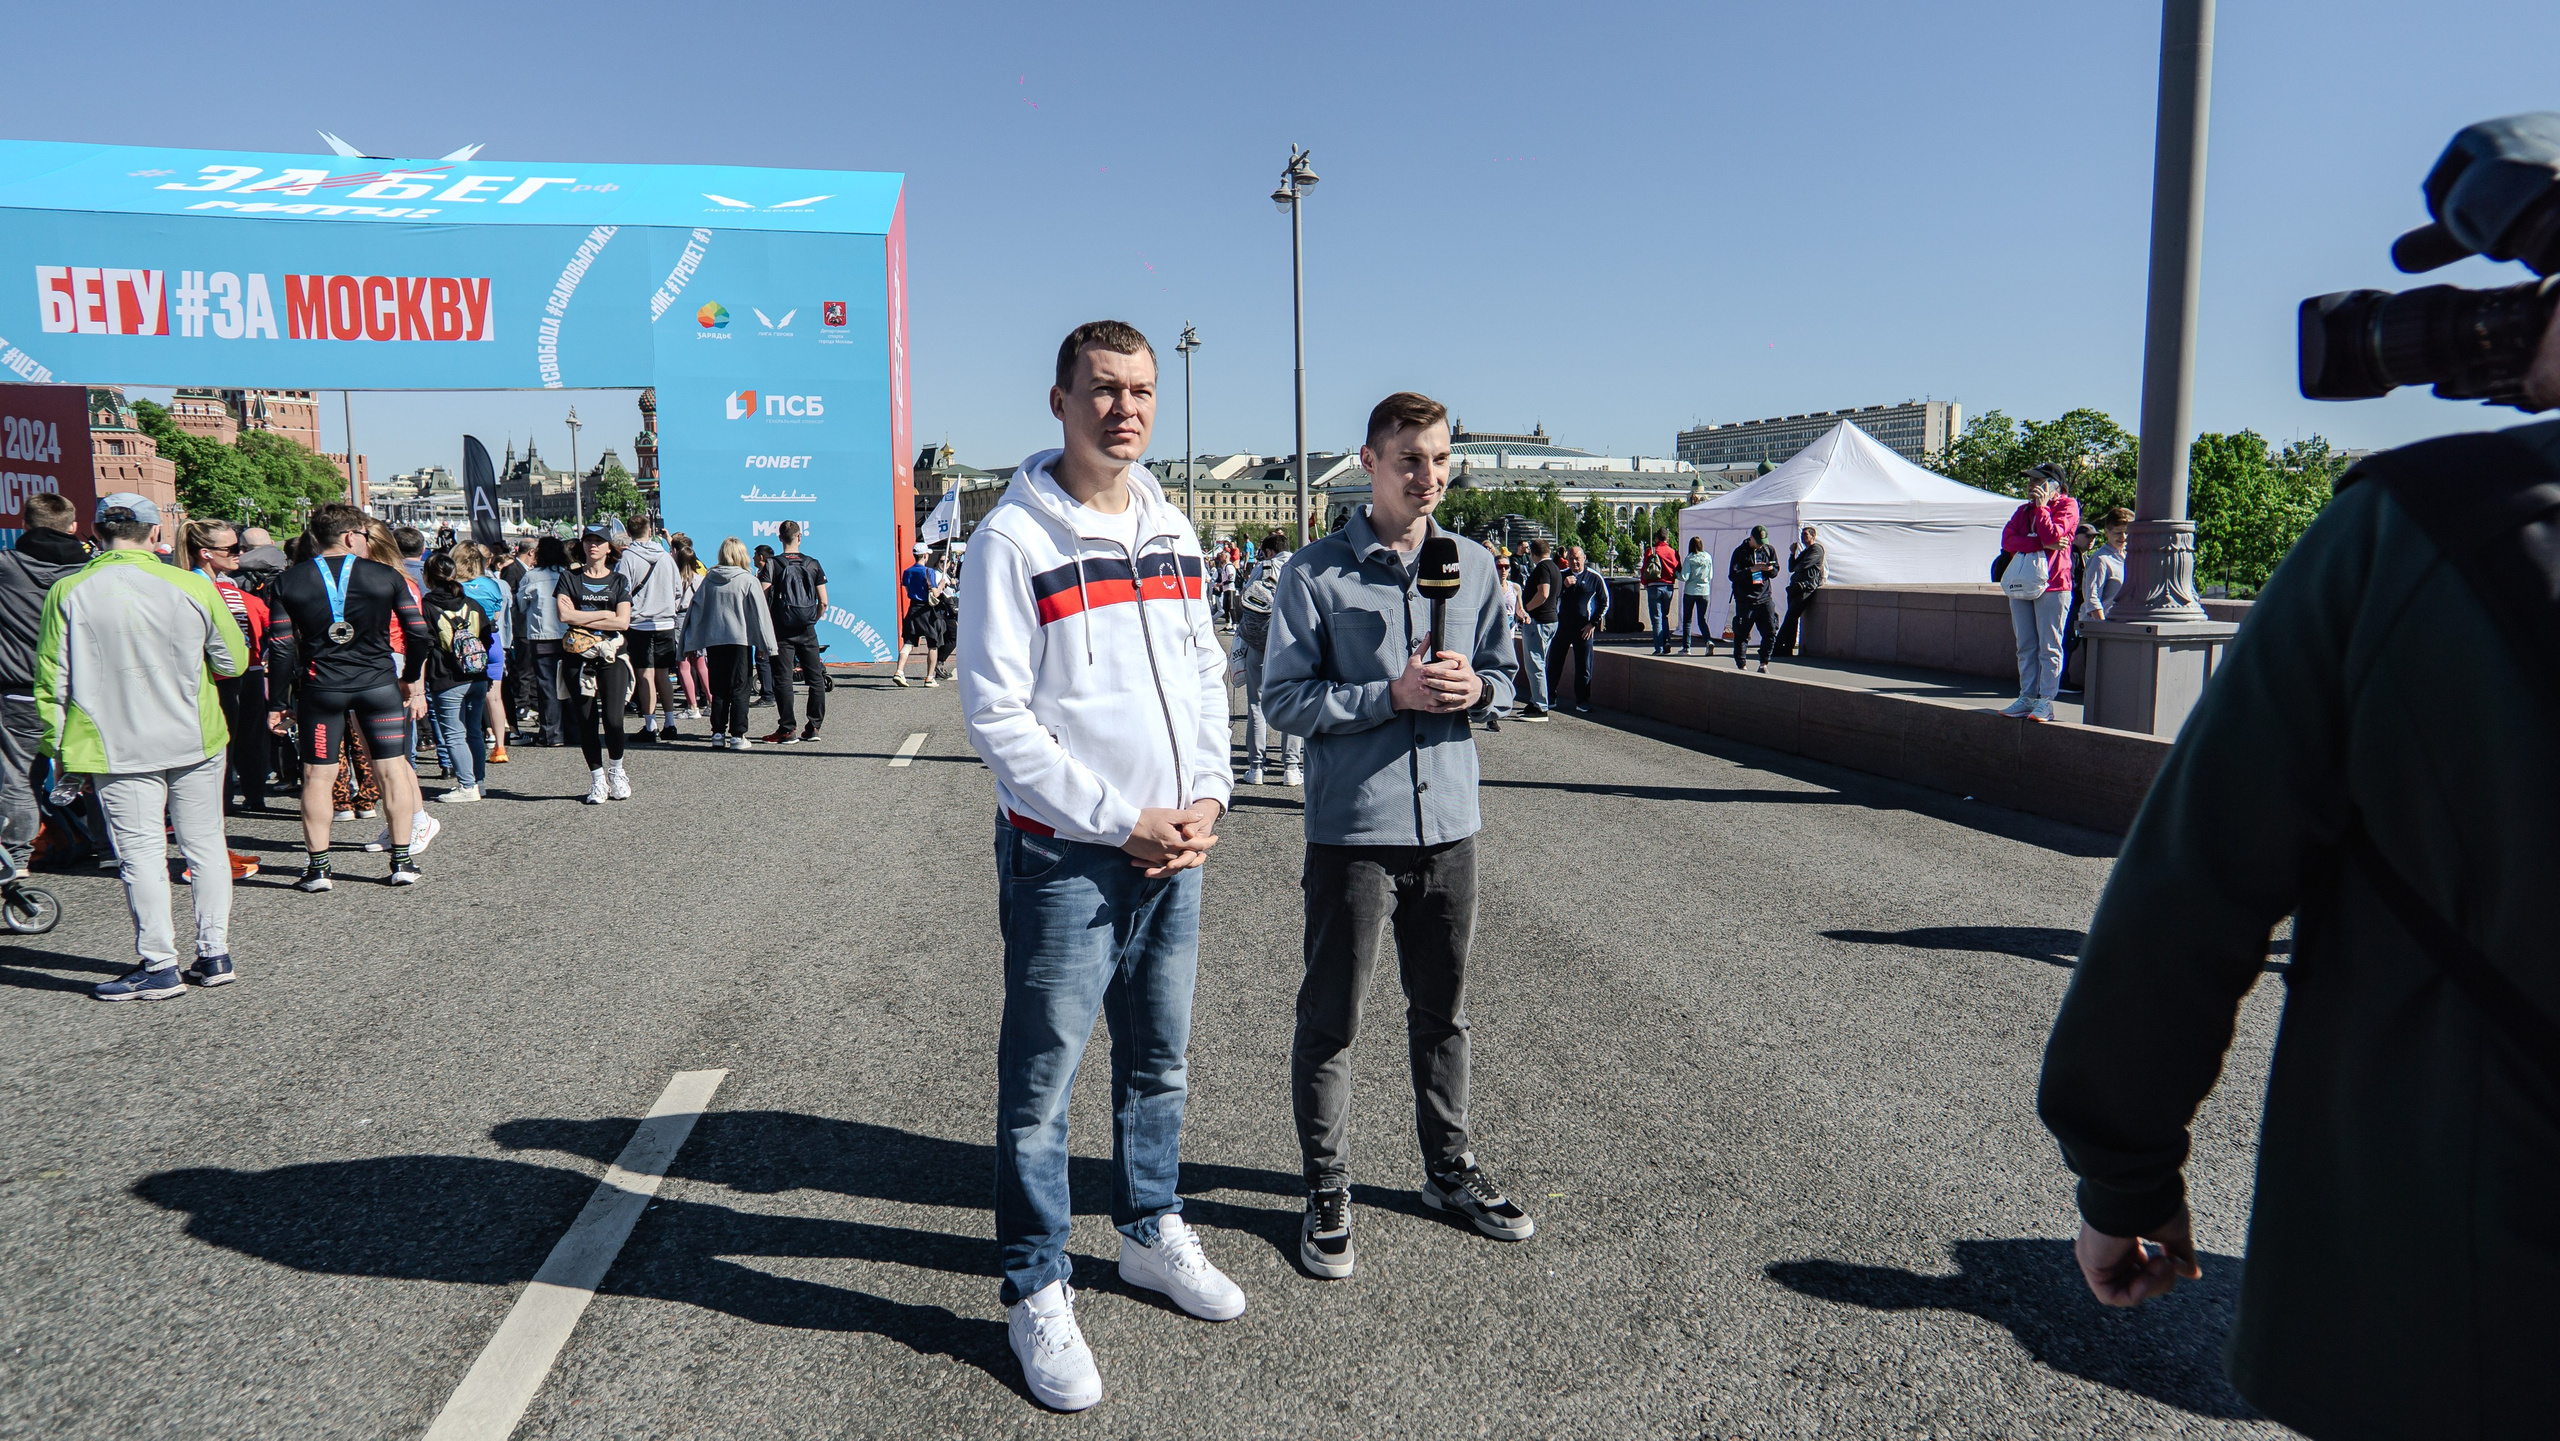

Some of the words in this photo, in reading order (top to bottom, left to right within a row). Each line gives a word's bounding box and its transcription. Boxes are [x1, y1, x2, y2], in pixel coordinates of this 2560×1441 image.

[664, 239, 706, 296] #ТРЕПЕТ
[36, 265, 170, 336] БЕГУ
[175, 271, 279, 339] #ЗА
[284, 274, 495, 341] МОСКВУ
[696, 331, 732, 340] ЗАРЯДЬЕ
[765, 395, 824, 417] ПСБ
[4, 415, 62, 464] 2024
[745, 455, 813, 469] FONBET
